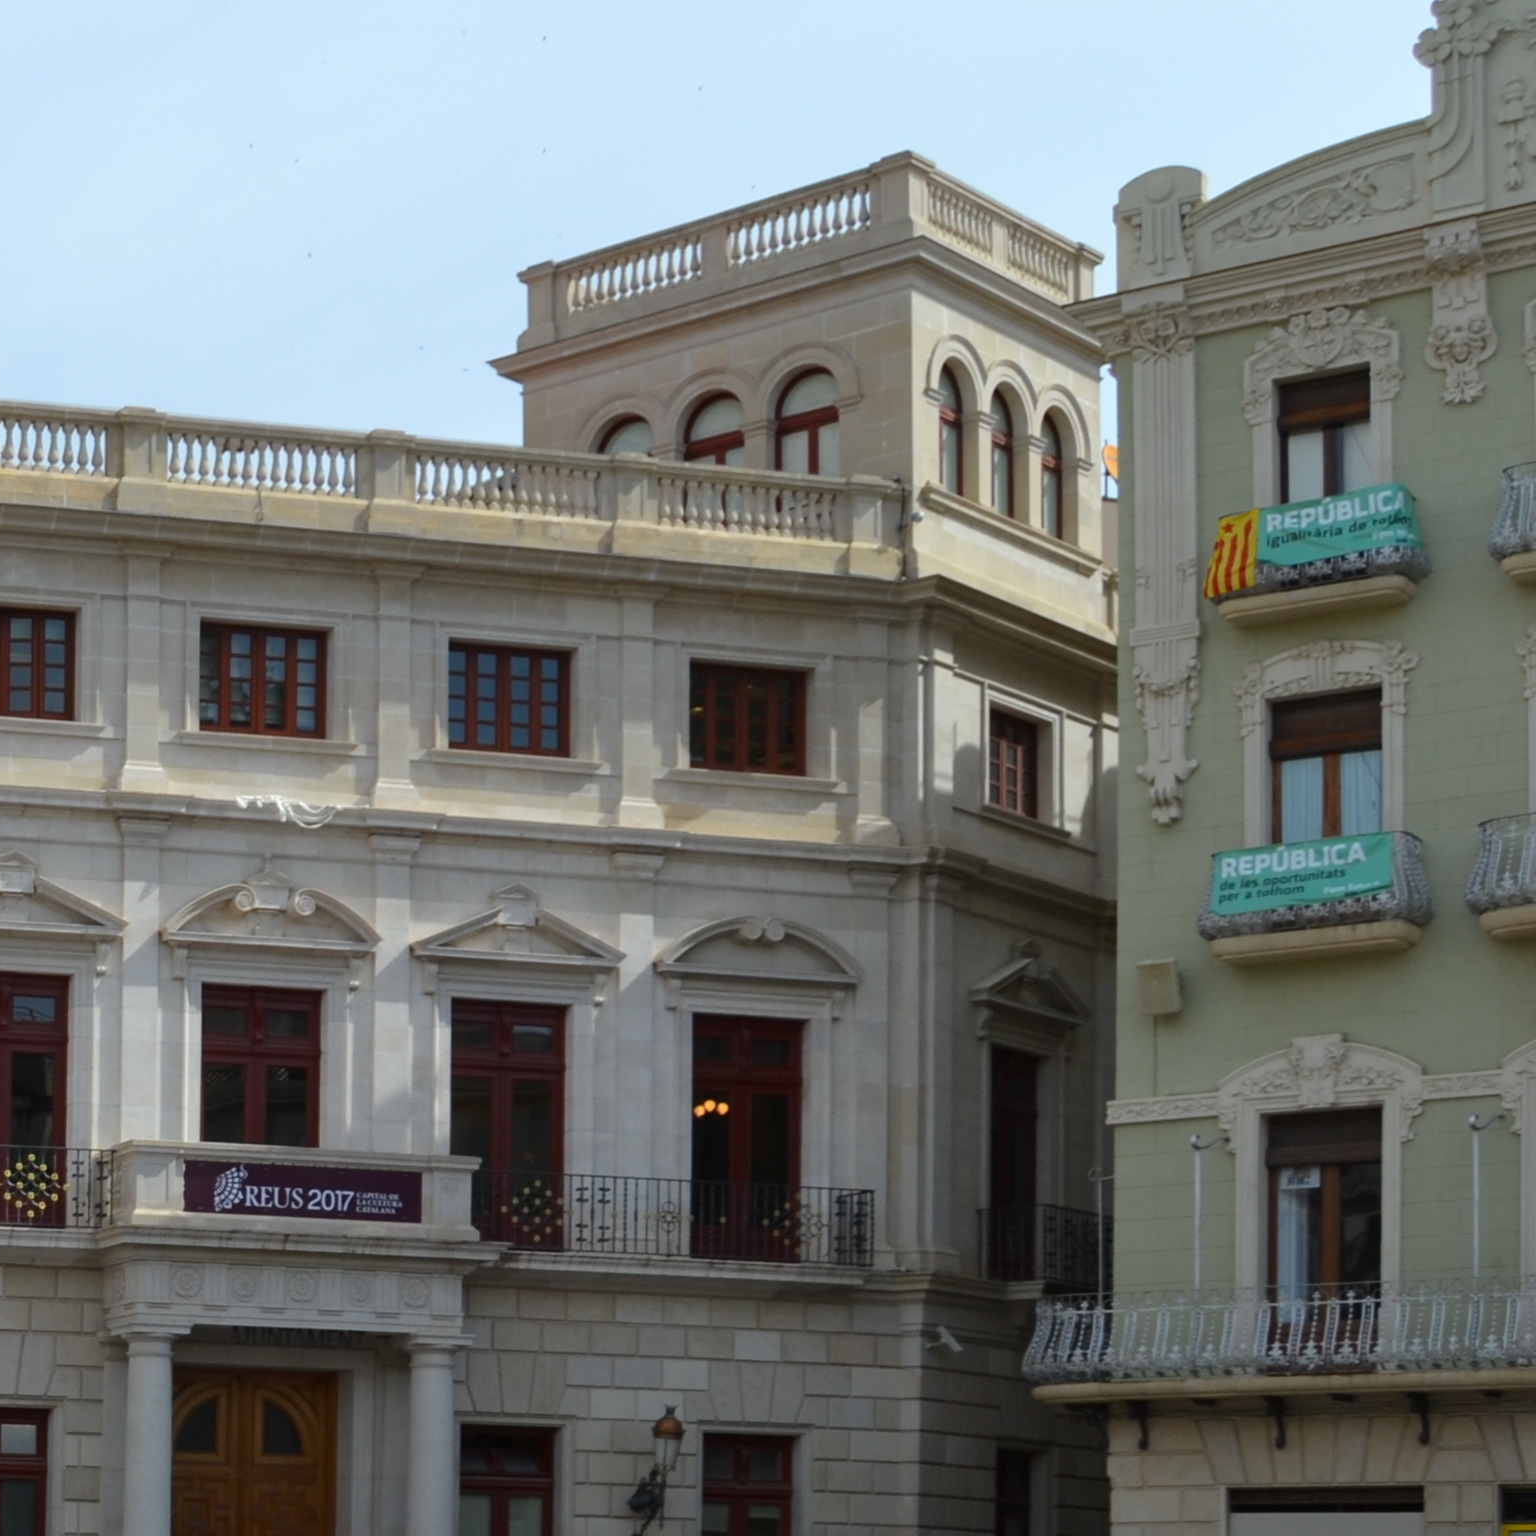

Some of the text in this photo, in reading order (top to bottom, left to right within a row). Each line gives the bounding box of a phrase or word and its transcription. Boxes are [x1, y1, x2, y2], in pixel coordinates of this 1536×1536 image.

[1266, 489, 1405, 532] REPÚBLICA
[1348, 521, 1367, 535] de
[1220, 842, 1368, 878] REPÚBLICA
[1219, 868, 1346, 892] de les oportunitats
[1218, 883, 1305, 905] per a tothom
[245, 1186, 355, 1212] REUS 2017
